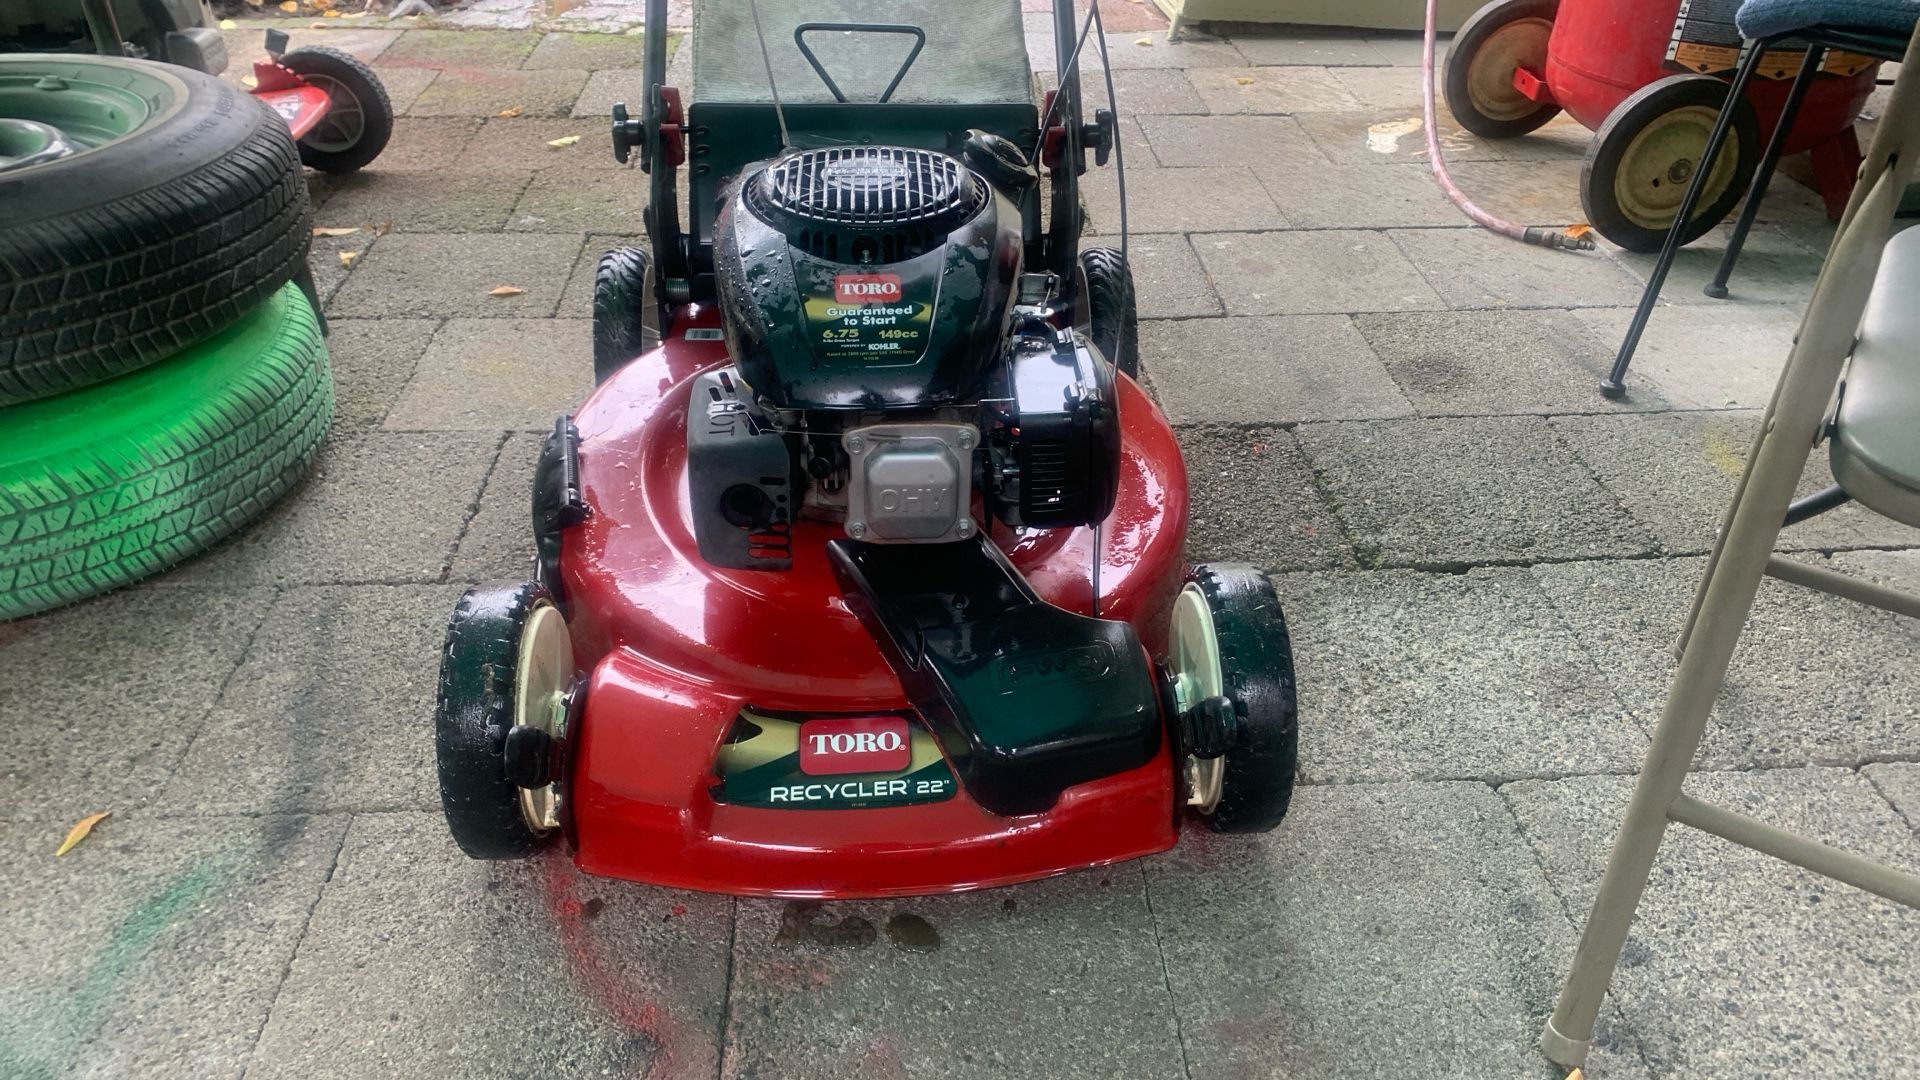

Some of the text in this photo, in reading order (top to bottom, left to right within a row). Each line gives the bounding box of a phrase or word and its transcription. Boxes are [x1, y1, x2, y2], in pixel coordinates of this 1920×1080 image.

[840, 282, 897, 295] TORO
[826, 305, 913, 316] Guaranteed
[844, 316, 896, 326] to Start
[822, 329, 919, 339] 6.75 149cc
[709, 403, 738, 436] HOT
[880, 488, 947, 513] OHV
[809, 731, 901, 755] TORO
[770, 779, 950, 802] RECYCLER 22"
